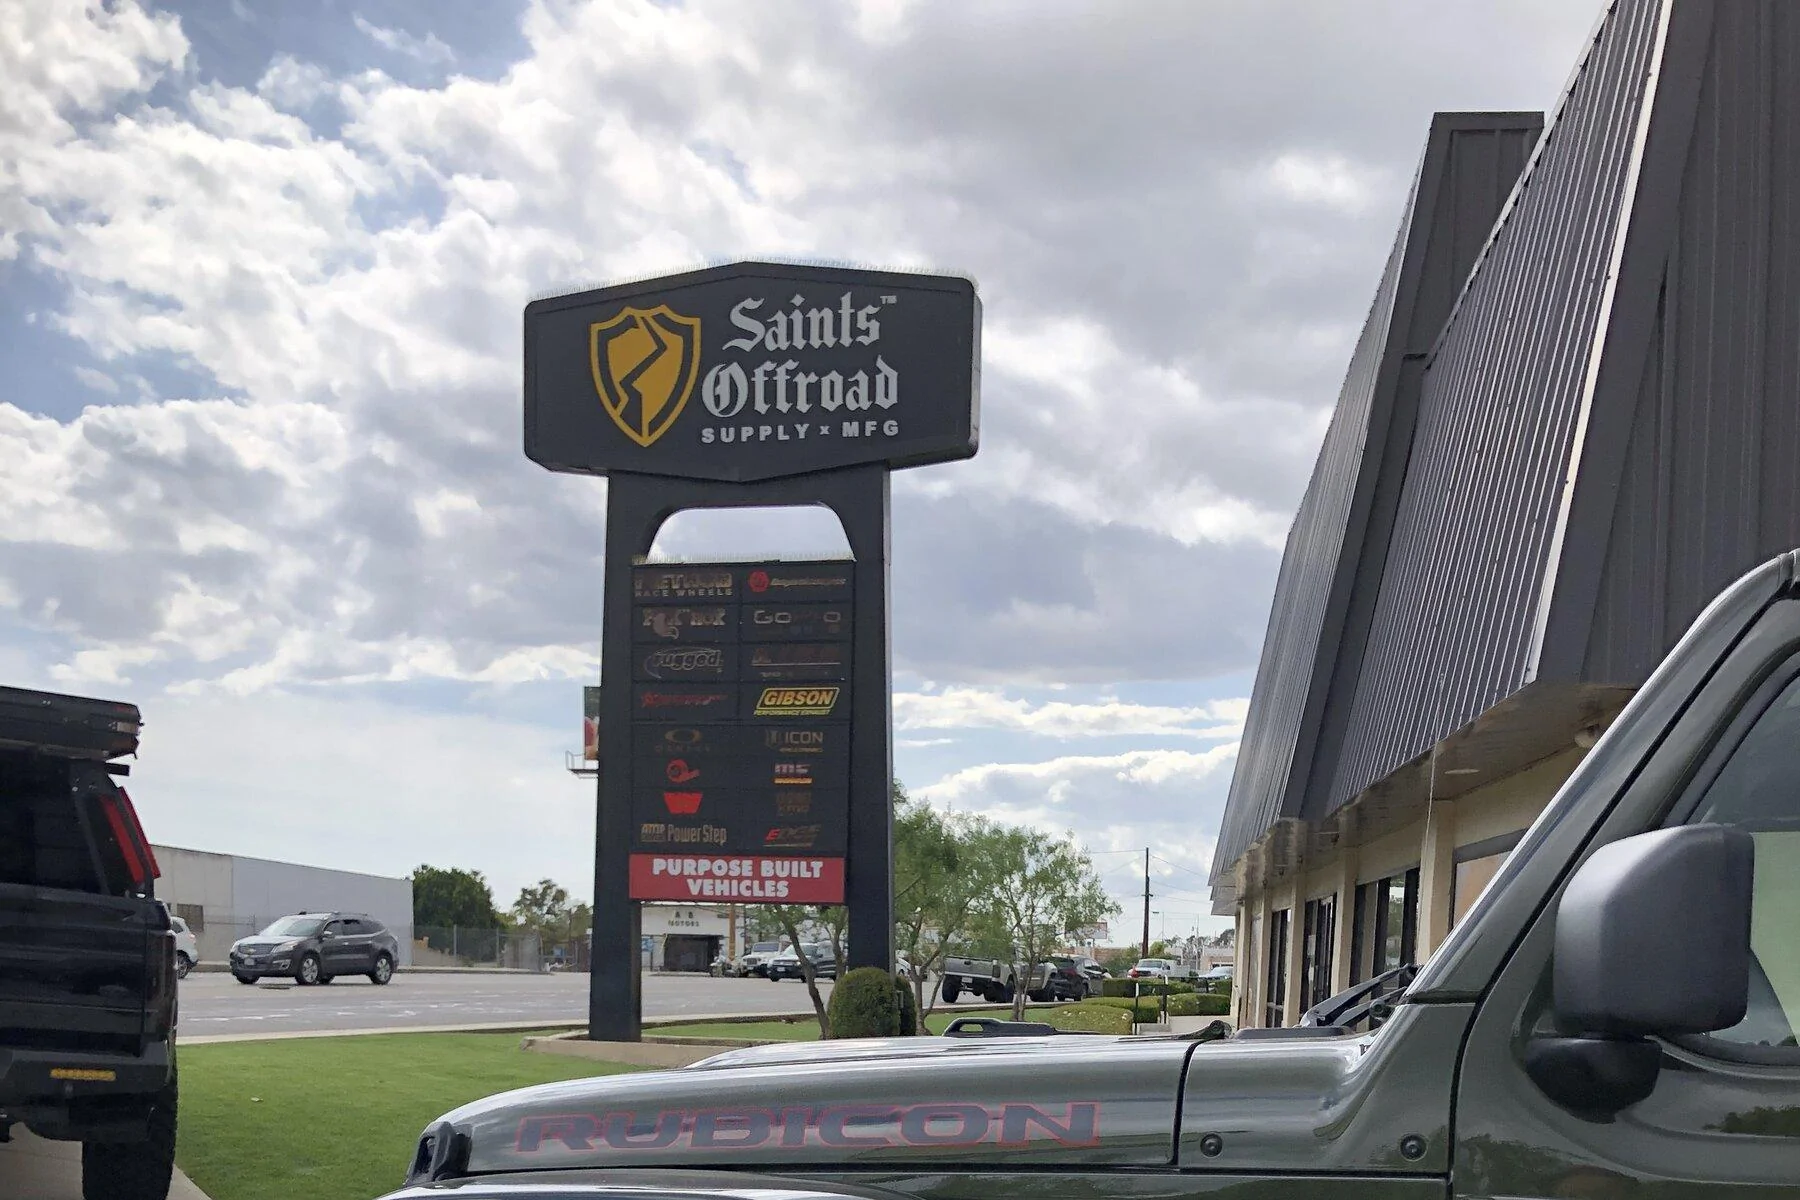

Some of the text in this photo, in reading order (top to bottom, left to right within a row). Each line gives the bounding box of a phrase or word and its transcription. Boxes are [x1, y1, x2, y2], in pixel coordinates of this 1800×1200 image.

[722, 291, 881, 353] Saints
[702, 355, 899, 418] Offroad
[701, 423, 810, 444] SUPPLY
[842, 420, 899, 438] MFG
[676, 587, 733, 597] WHEELS
[763, 690, 834, 706] GIBSON
[785, 731, 823, 744] ICON
[652, 858, 824, 878] PURPOSE BUILT
[686, 878, 790, 898] VEHICLES
[516, 1101, 1102, 1153] RUBICON
